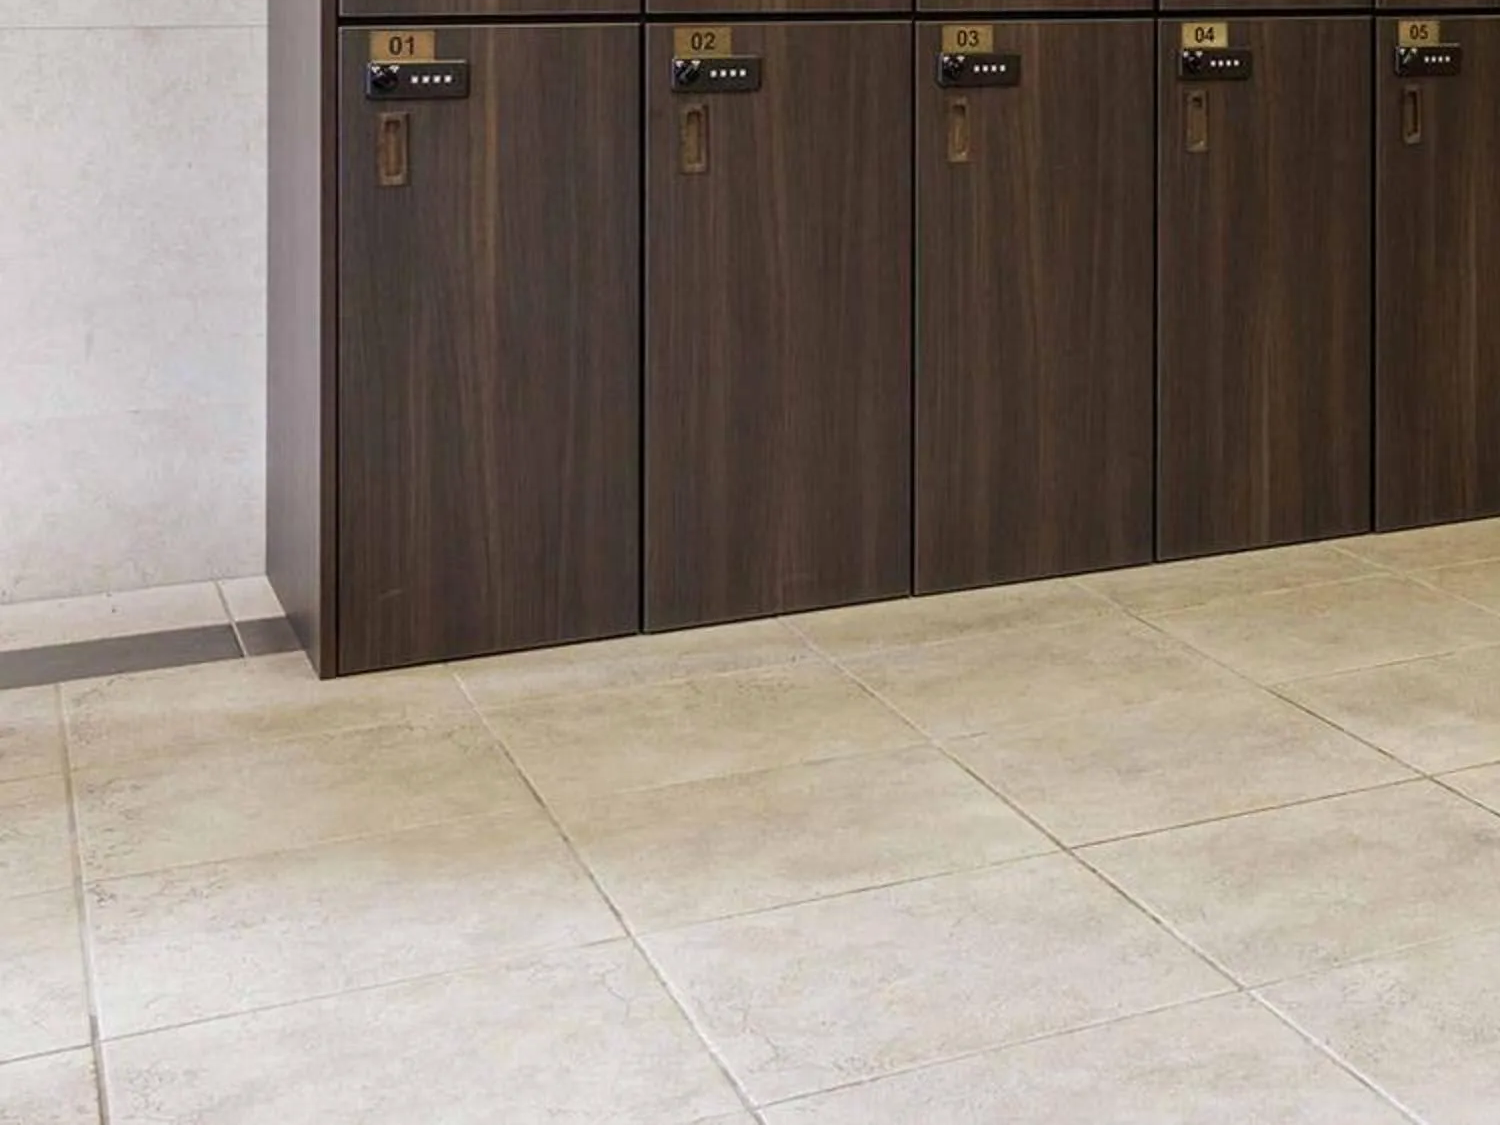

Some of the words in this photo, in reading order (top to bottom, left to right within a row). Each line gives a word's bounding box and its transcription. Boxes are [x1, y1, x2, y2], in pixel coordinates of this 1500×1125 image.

[957, 30, 979, 47] 03
[1195, 27, 1214, 42] 04
[1410, 25, 1428, 39] 05
[389, 36, 414, 55] 01
[691, 32, 715, 50] 02
